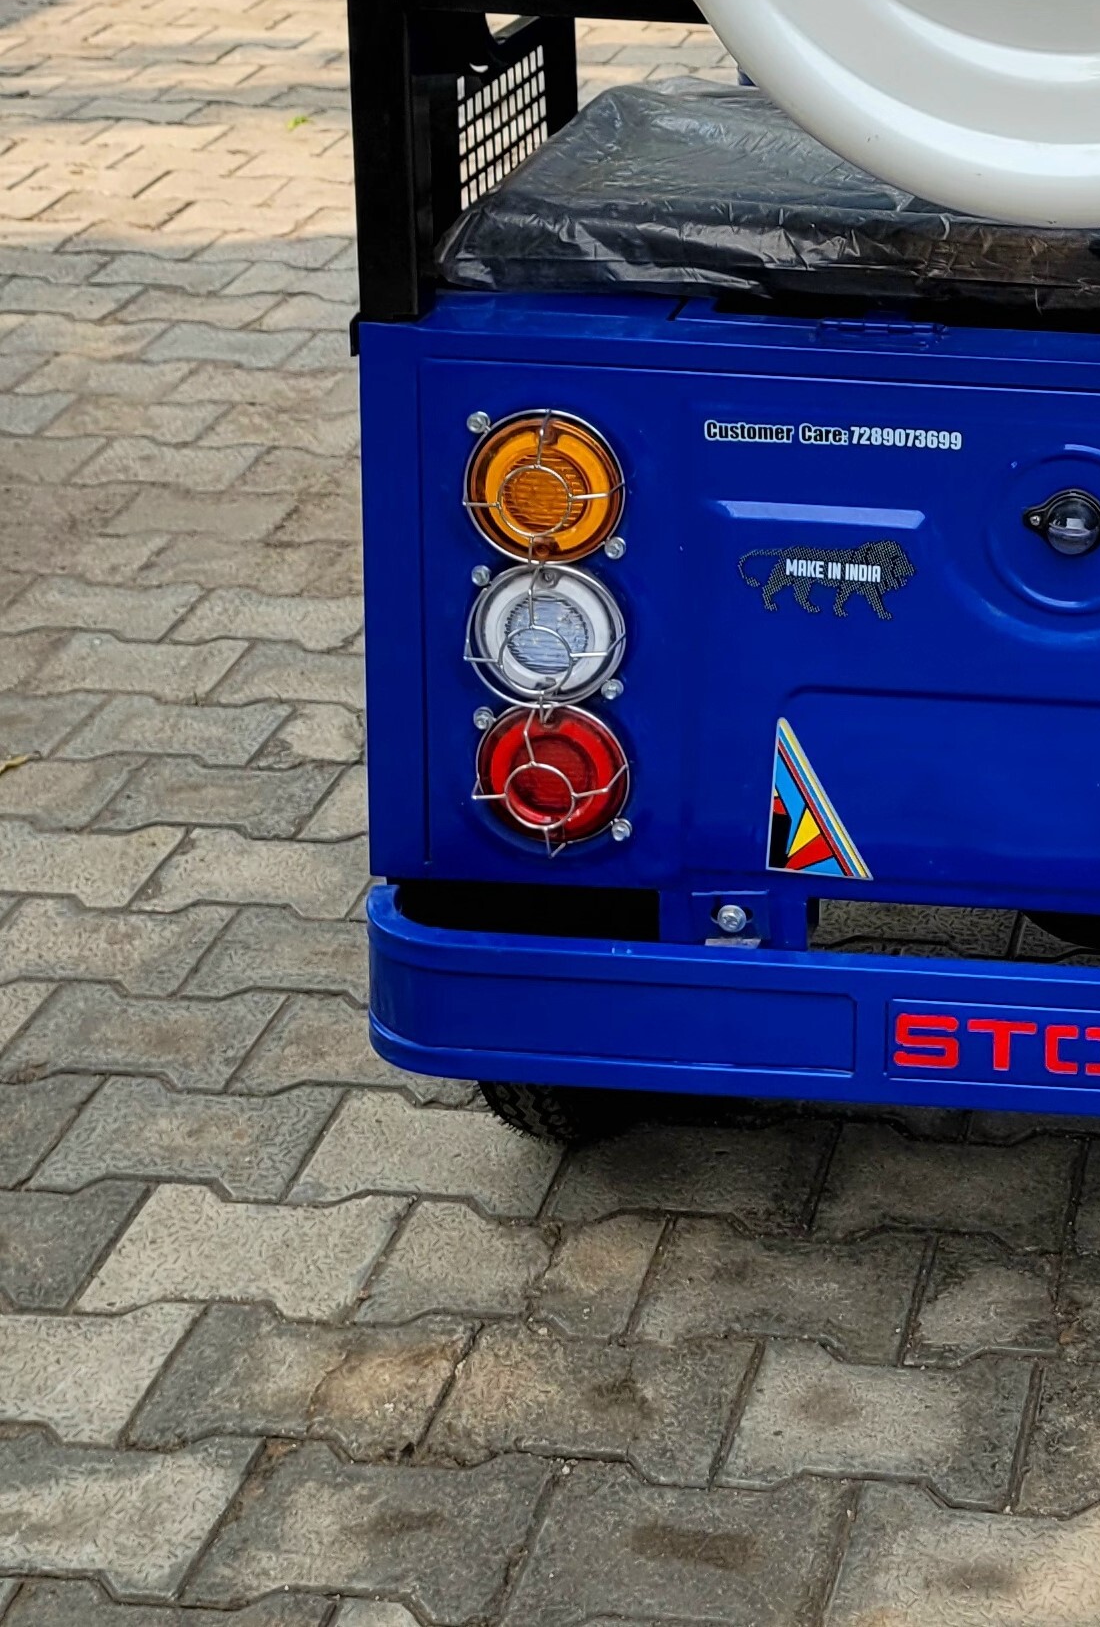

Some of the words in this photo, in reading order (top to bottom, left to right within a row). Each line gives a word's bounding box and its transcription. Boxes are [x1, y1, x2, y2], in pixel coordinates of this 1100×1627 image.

[704, 419, 794, 443] Customer
[785, 558, 825, 579] MAKE
[828, 561, 841, 580] IN
[845, 563, 881, 583] INDIA
